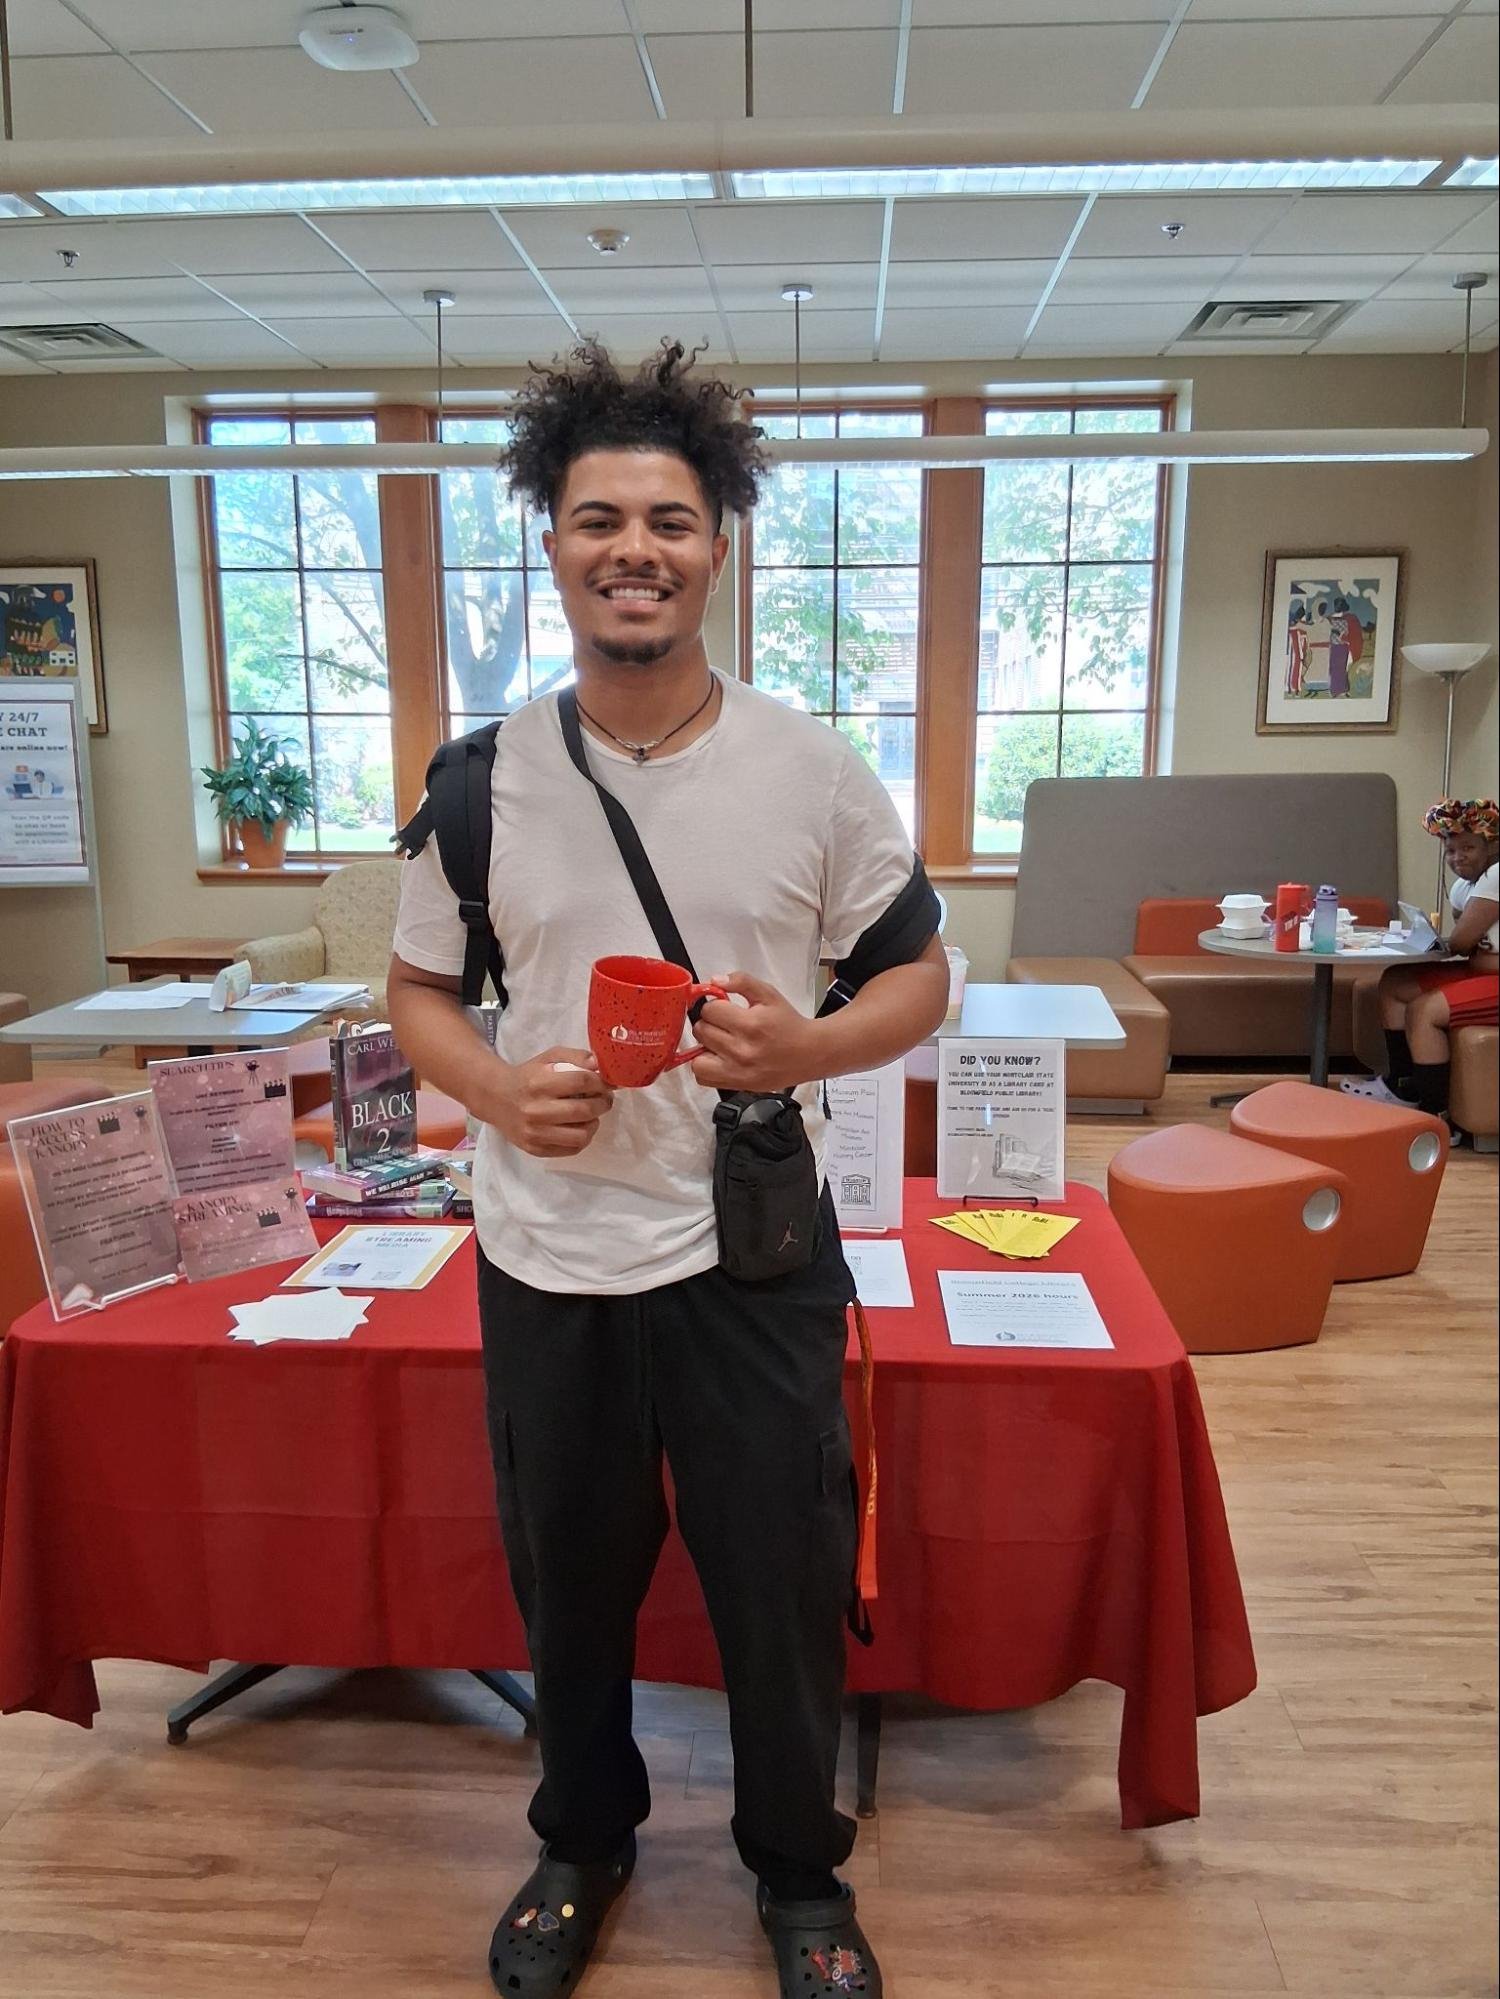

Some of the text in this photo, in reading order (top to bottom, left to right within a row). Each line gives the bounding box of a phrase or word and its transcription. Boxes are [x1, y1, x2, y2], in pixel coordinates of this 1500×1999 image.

[9, 712, 39, 723] 24/7
[7, 727, 47, 737] CHAT
[347, 1041, 375, 1056] CARL
[960, 1055, 1041, 1066] DID YOU KNOW?
[351, 1091, 414, 1129] BLACK
[377, 1127, 391, 1154] 2
[365, 1188, 377, 1197] WE
[957, 1291, 1007, 1299] Summer
